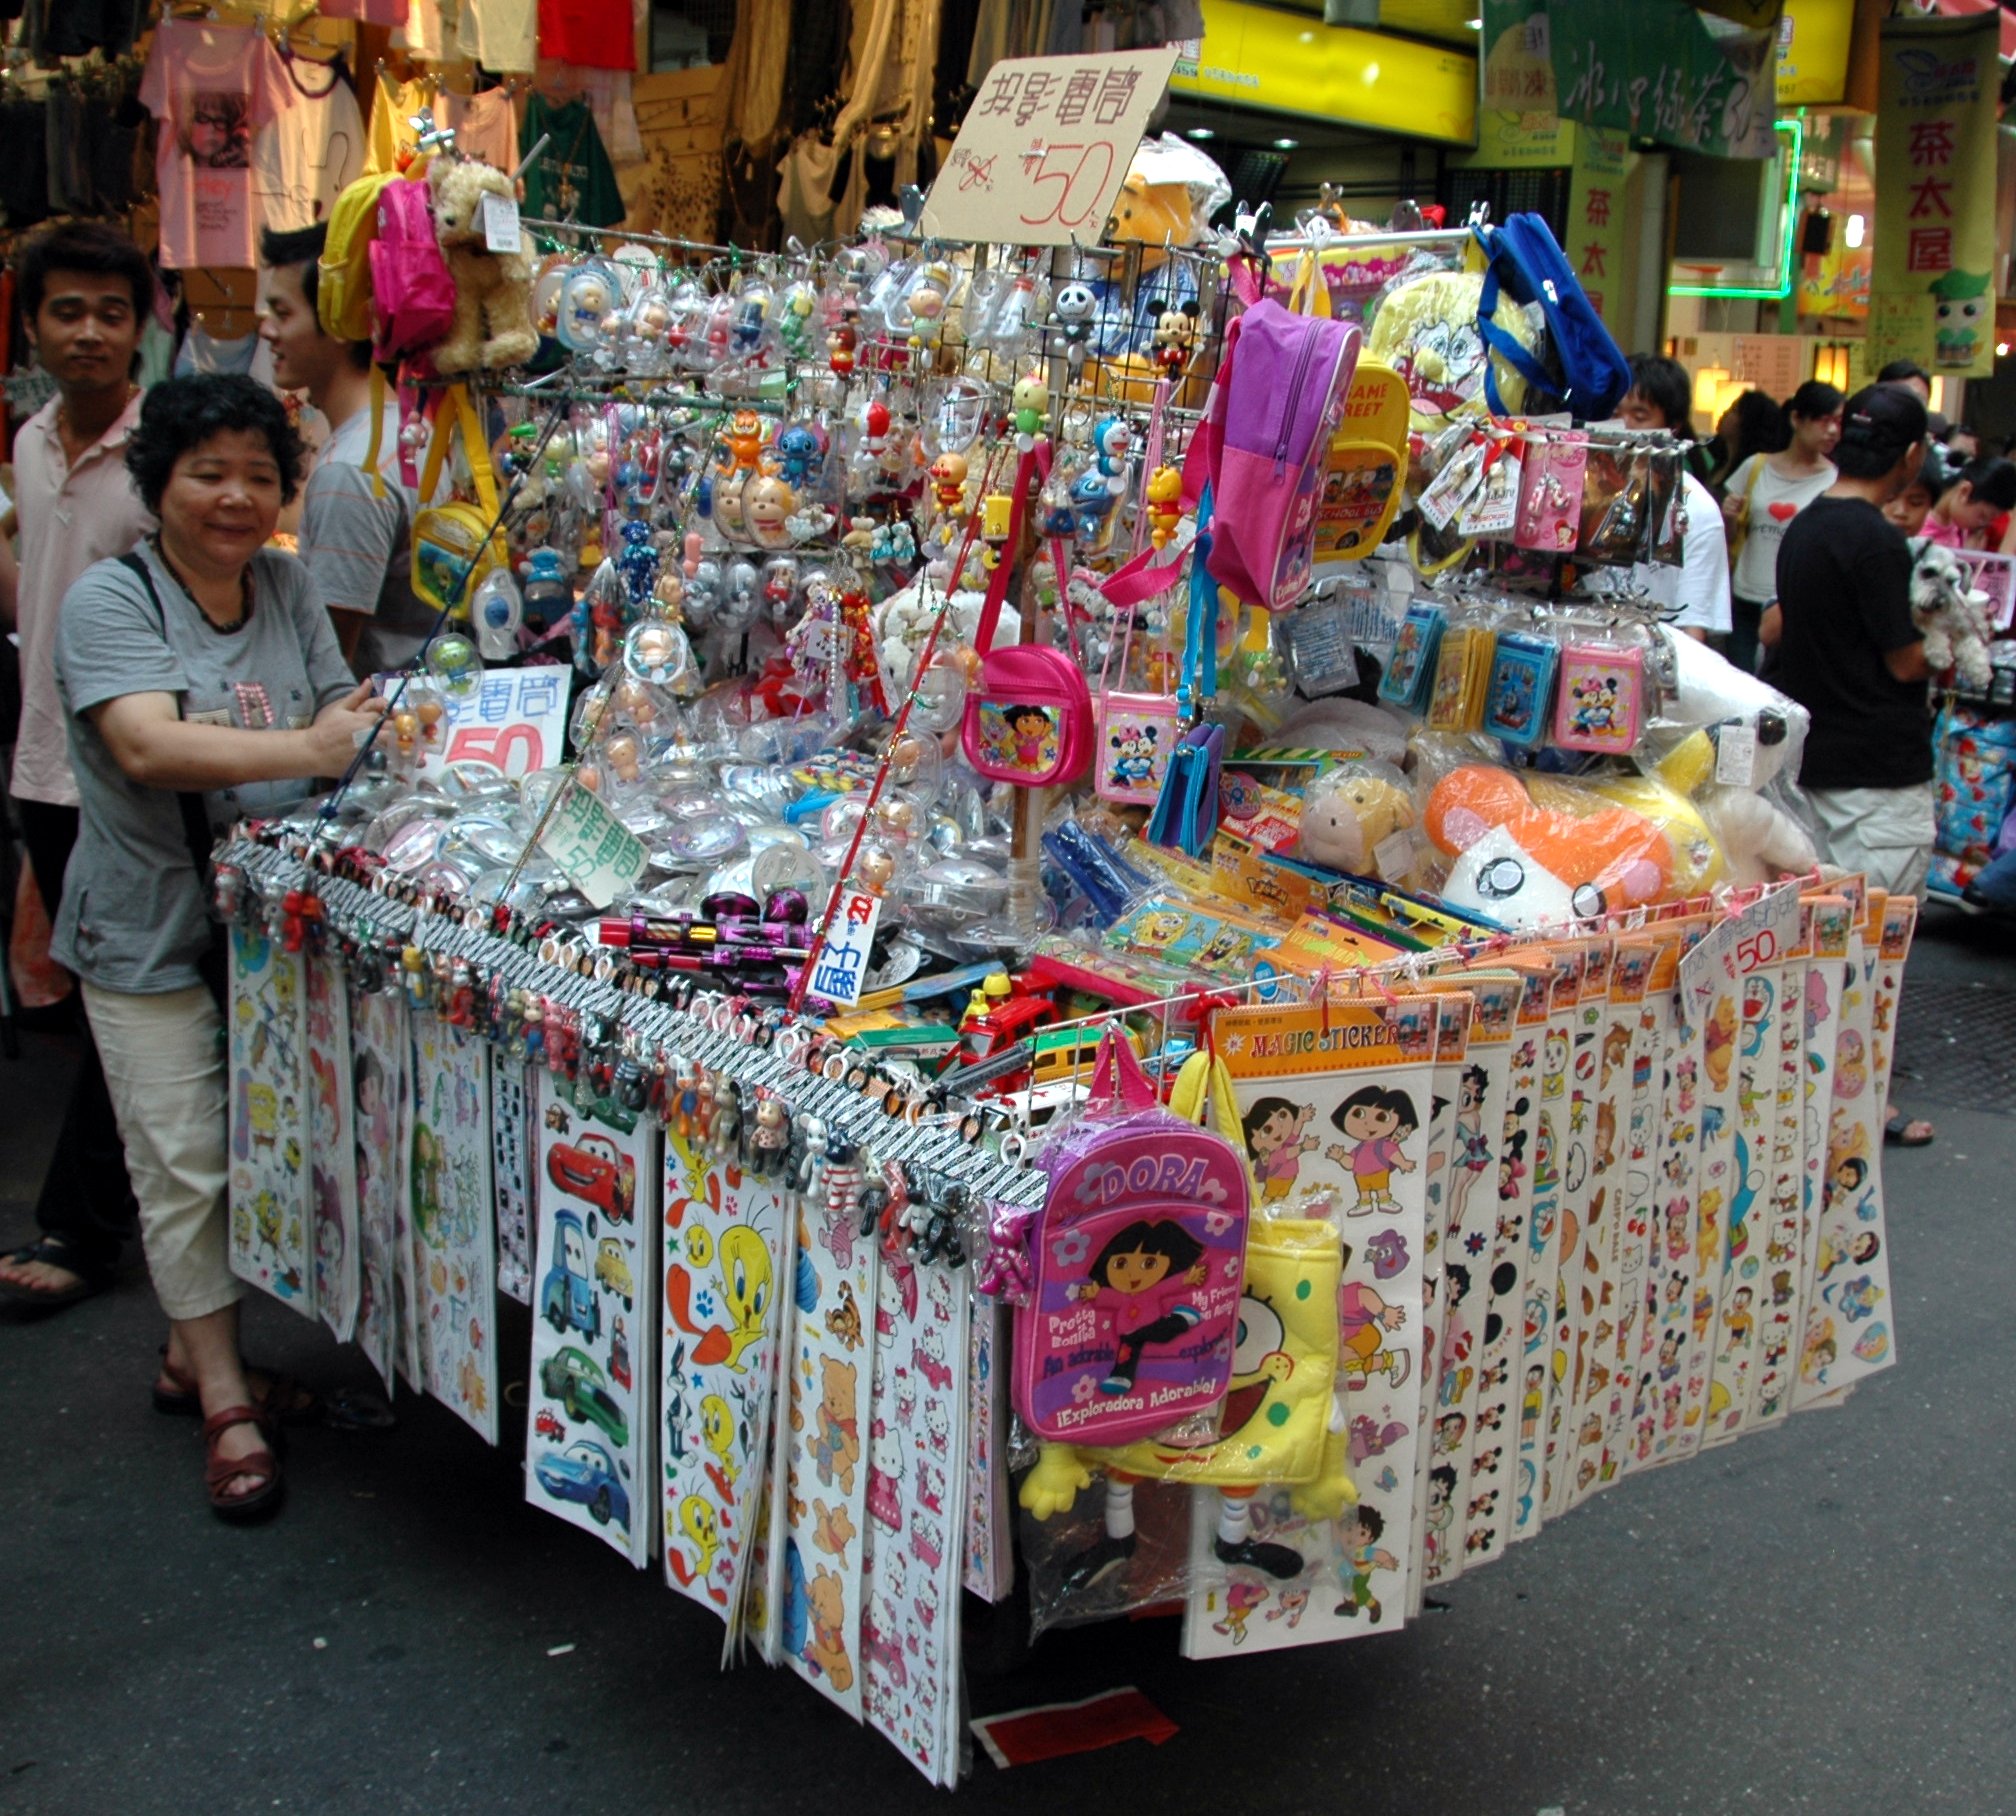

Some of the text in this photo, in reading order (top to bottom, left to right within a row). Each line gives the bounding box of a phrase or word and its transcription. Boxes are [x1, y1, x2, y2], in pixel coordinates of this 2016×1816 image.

[1908, 120, 1954, 273] 茶太屋
[1251, 1023, 1401, 1058] MAGIC STICKER
[1101, 1153, 1209, 1206] DORA
